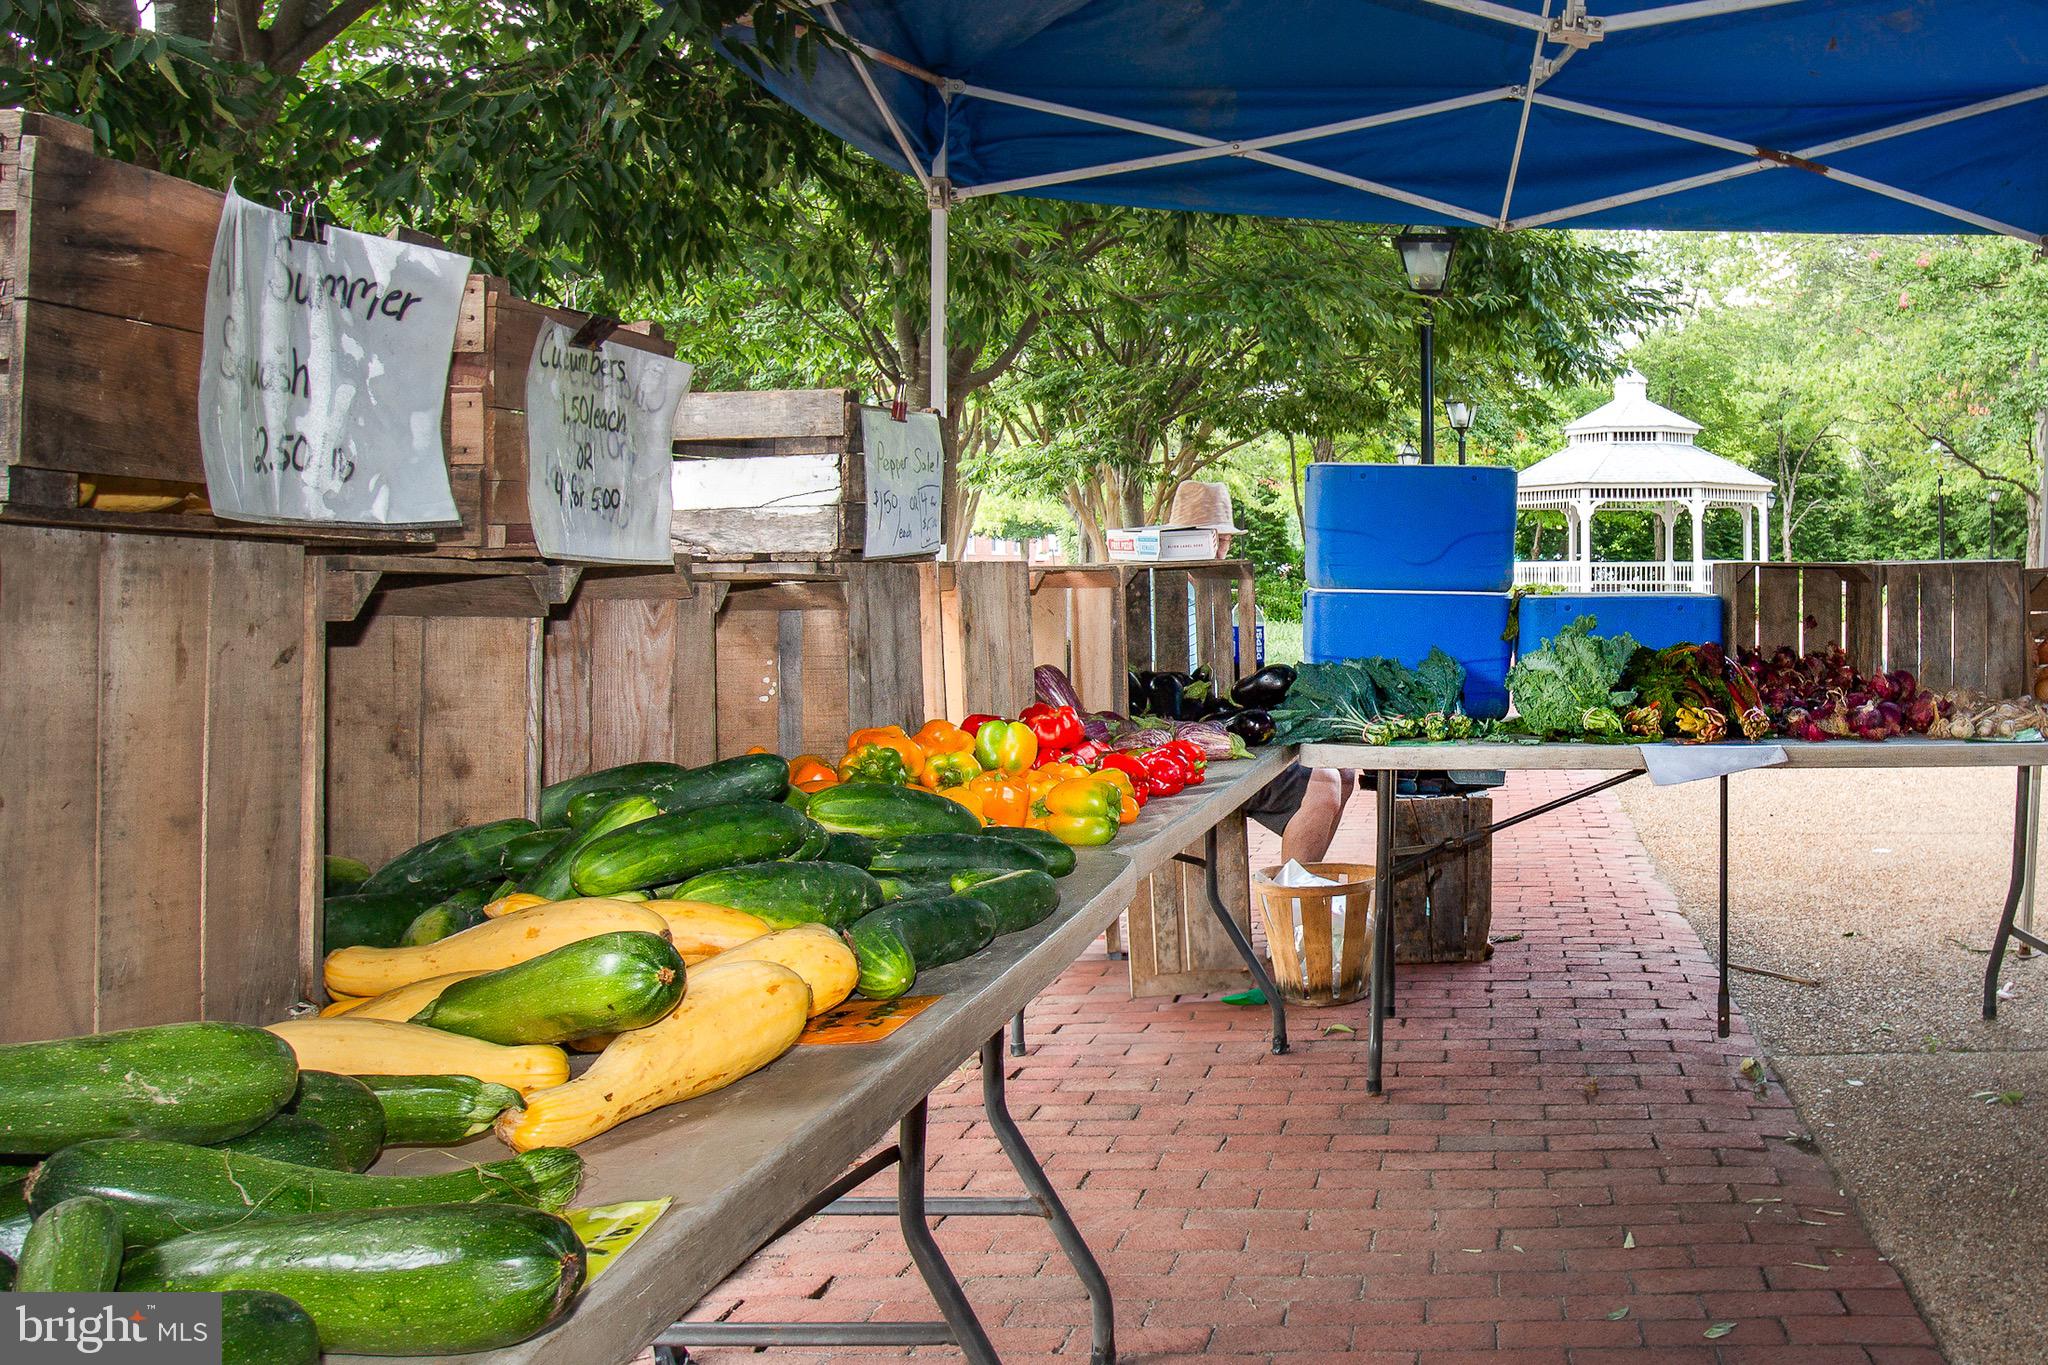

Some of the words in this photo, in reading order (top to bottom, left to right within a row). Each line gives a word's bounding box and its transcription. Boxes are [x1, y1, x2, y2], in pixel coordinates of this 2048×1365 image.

[270, 236, 423, 321] Summer
[539, 329, 626, 383] Cucumbers
[576, 443, 594, 471] OR
[877, 440, 909, 480] Pepper
[913, 447, 940, 474] Sale!
[554, 471, 564, 507] 4
[569, 473, 585, 509] for
